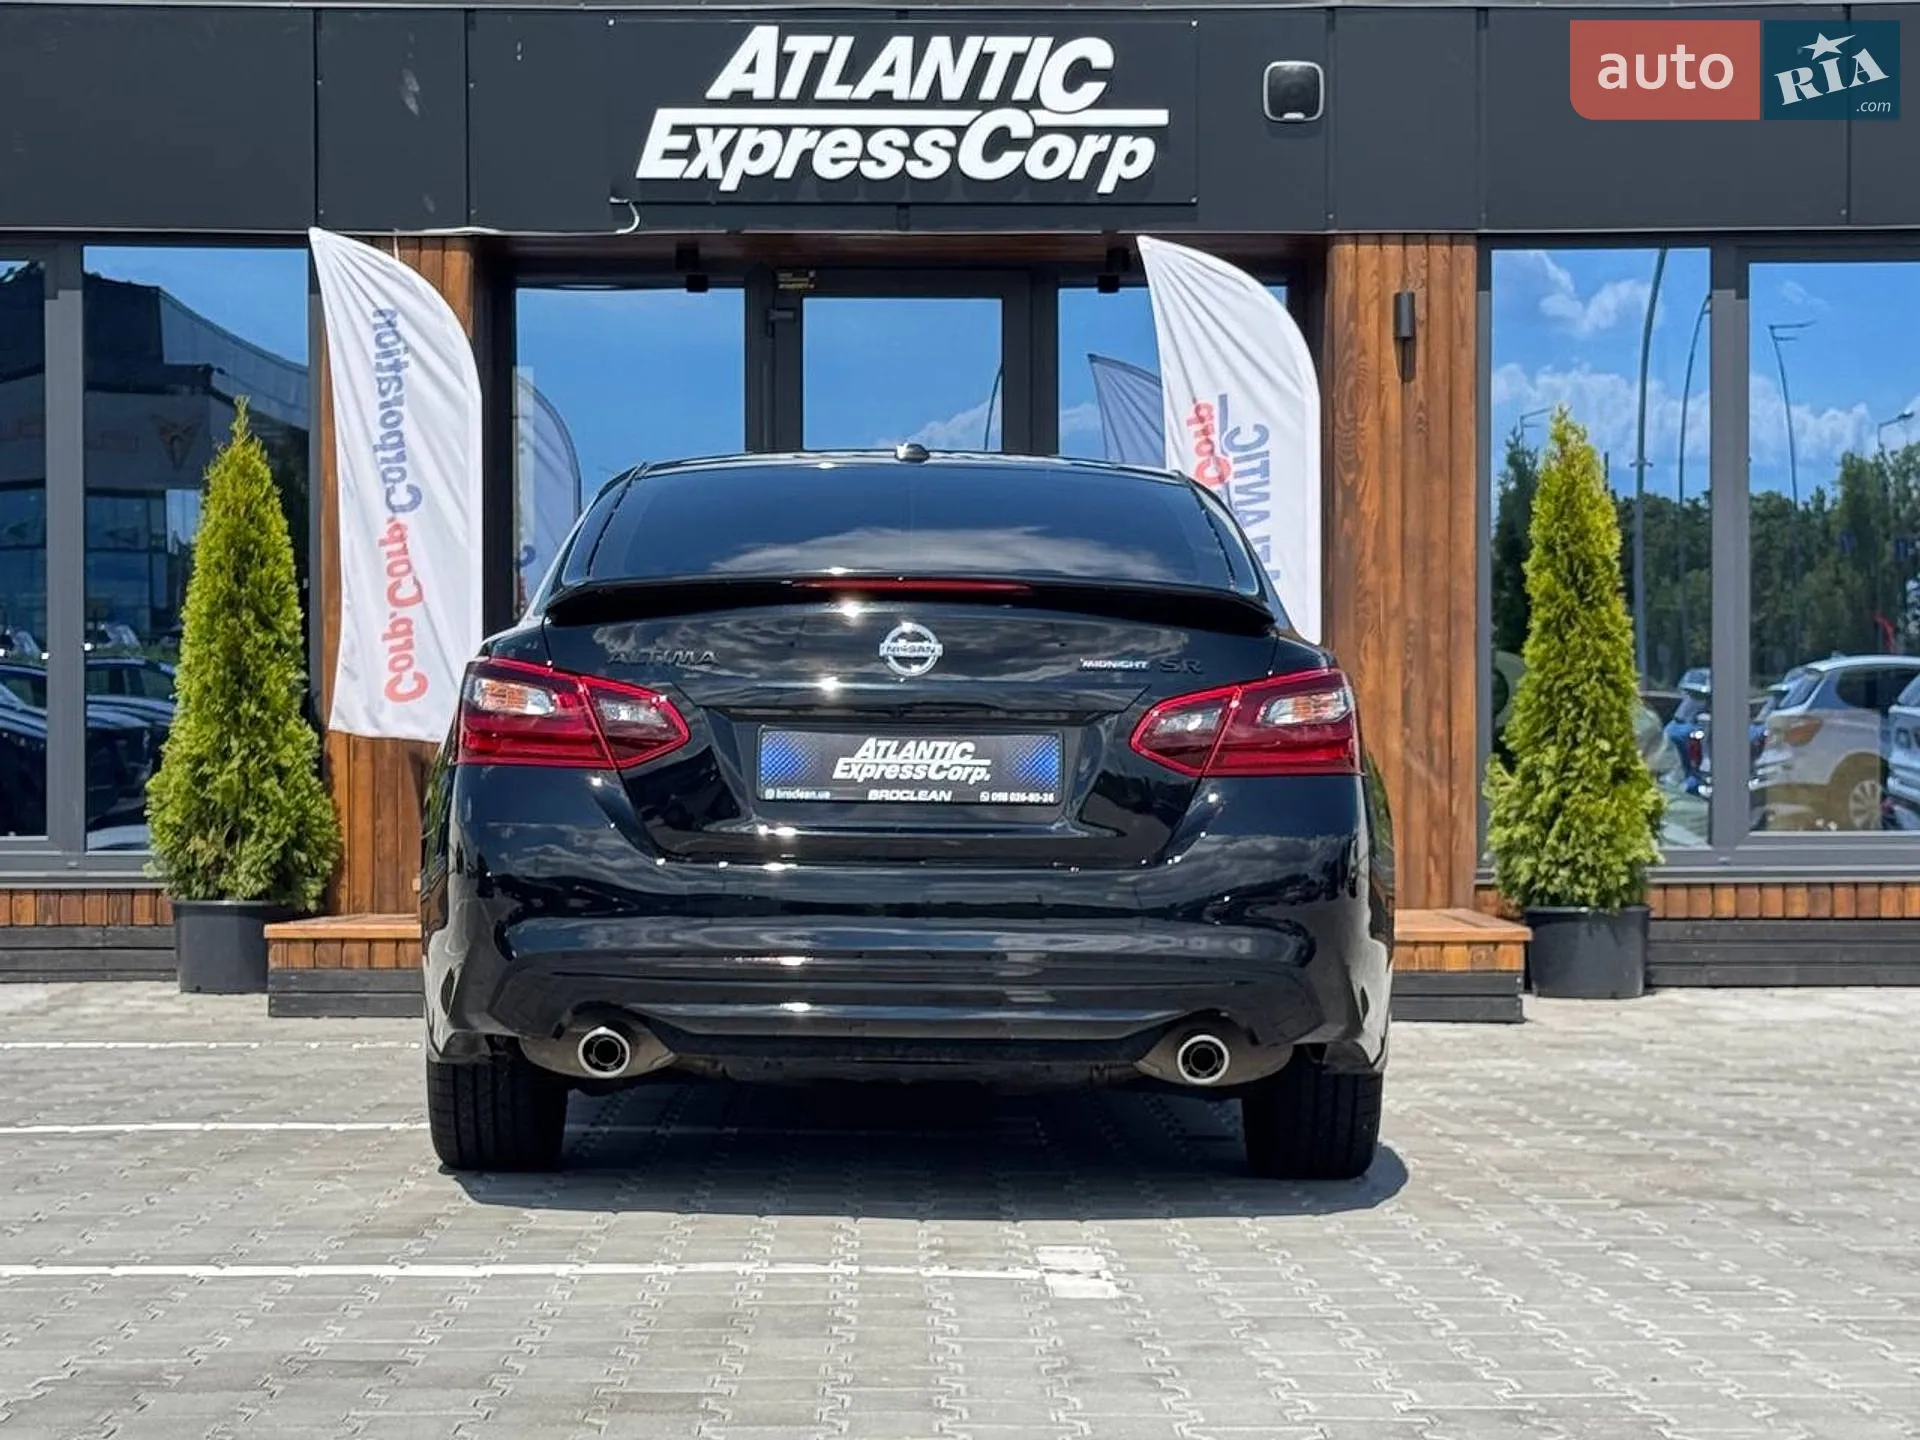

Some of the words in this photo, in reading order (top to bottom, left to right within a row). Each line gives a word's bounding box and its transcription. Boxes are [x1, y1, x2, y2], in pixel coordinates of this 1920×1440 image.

[705, 25, 1114, 113] ATLANTIC
[635, 108, 1156, 194] ExpressCorp
[607, 647, 720, 665] ALTIMA
[1080, 657, 1149, 670] MIDNIGHT
[1160, 658, 1203, 674] SR
[853, 737, 976, 760] ATLANTIC
[832, 757, 992, 785] ExpressCorp.
[867, 789, 952, 802] BROCLEAN
